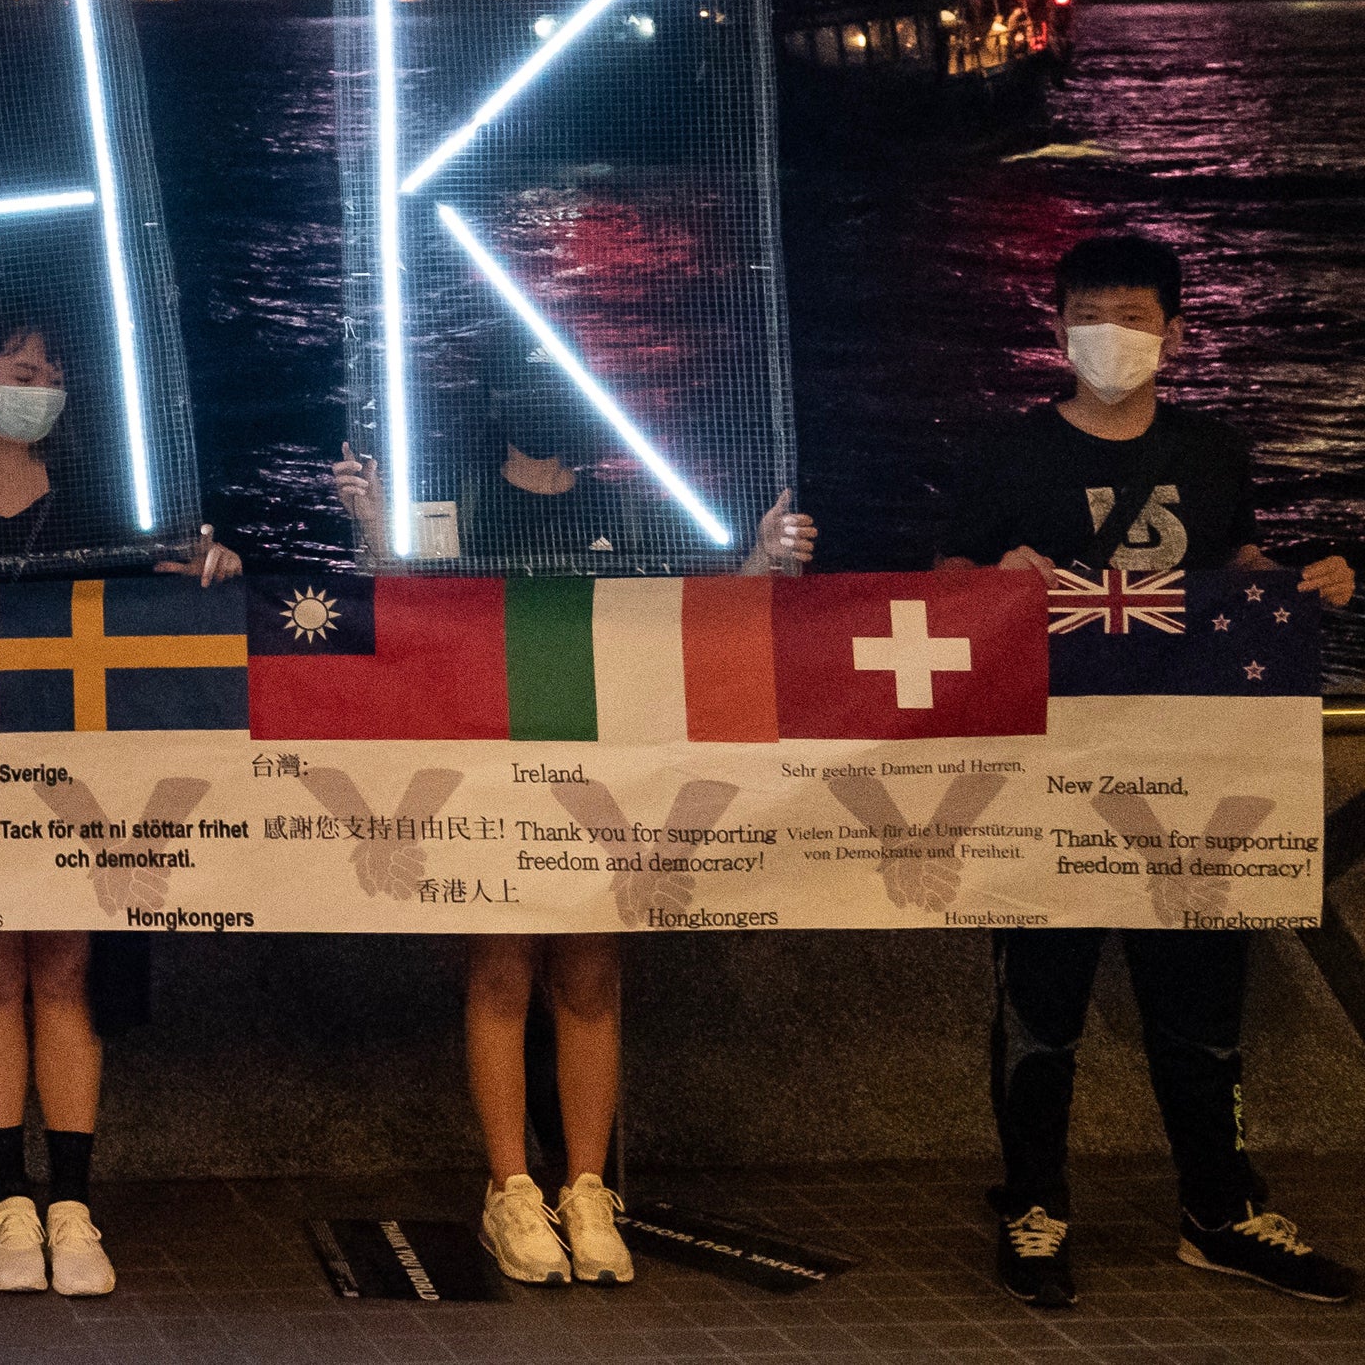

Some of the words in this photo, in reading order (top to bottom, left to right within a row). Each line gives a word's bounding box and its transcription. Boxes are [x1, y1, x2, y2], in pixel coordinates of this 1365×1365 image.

[0, 764, 73, 785] Sverige,
[252, 753, 308, 778] 台灣:
[512, 763, 590, 784] Ireland,
[782, 764, 817, 777] Sehr
[822, 765, 876, 780] geehrte
[881, 763, 933, 775] Damen
[938, 760, 965, 774] und
[970, 759, 1026, 774] Herren,
[1047, 776, 1093, 794] New
[1099, 776, 1189, 796] Zealand,
[0, 820, 43, 839] Tack
[47, 820, 74, 838] för
[80, 820, 104, 838] att
[110, 820, 126, 838] ni
[132, 819, 193, 838] stöttar
[199, 819, 249, 838] frihet
[264, 816, 505, 840] 感謝您支持自由民主!
[516, 821, 581, 842] Thank
[587, 827, 626, 844] you
[632, 823, 662, 843] for
[667, 824, 777, 844] supporting
[1050, 829, 1118, 848] Thank
[1122, 833, 1162, 851] you
[1169, 831, 1200, 849] for
[1205, 832, 1319, 852] supporting
[56, 849, 90, 868] och
[96, 849, 196, 868] demokrati.
[517, 851, 600, 871] freedom
[606, 852, 643, 872] and
[649, 852, 764, 872] democracy!
[1057, 856, 1139, 875] freedom
[1146, 858, 1183, 876] and
[1189, 858, 1311, 879] democracy!
[419, 879, 519, 903] 香港人上
[127, 908, 254, 931] Hongkongers
[647, 908, 778, 928] Hongkongers
[945, 912, 1048, 927] Hongkongers
[1183, 911, 1318, 929] Hongkongers
